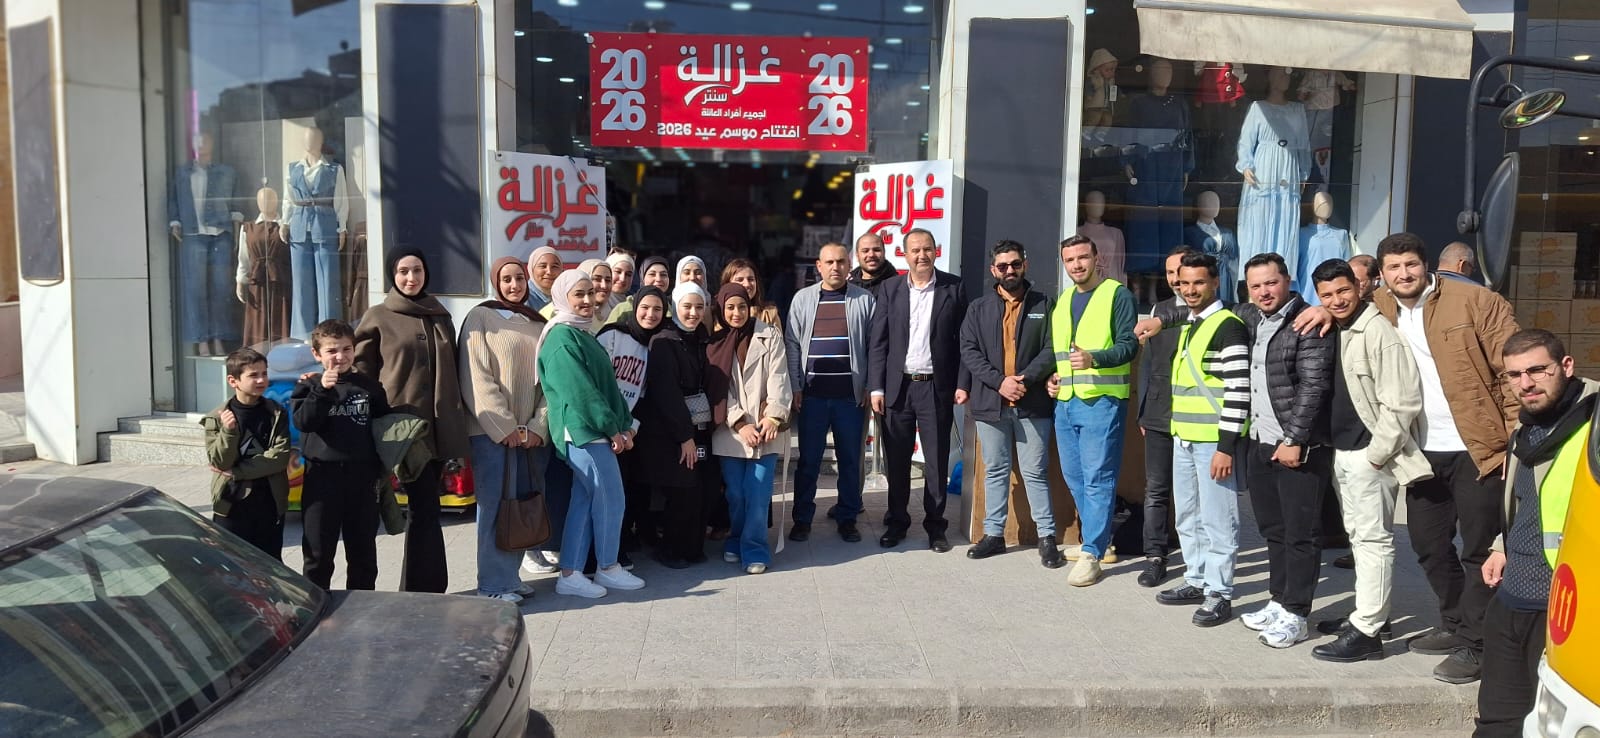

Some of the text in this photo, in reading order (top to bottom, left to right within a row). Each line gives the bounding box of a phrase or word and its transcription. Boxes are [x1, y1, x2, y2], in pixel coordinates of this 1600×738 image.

[600, 48, 647, 90] 20
[677, 42, 781, 95] غزالة
[808, 53, 855, 95] 20
[600, 90, 647, 131] 26
[701, 89, 728, 104] سنتر
[807, 95, 853, 136] 26
[657, 123, 800, 140] افتتاح موسم عيد 2026
[498, 165, 599, 228] غزالة
[859, 173, 945, 234] غزالة
